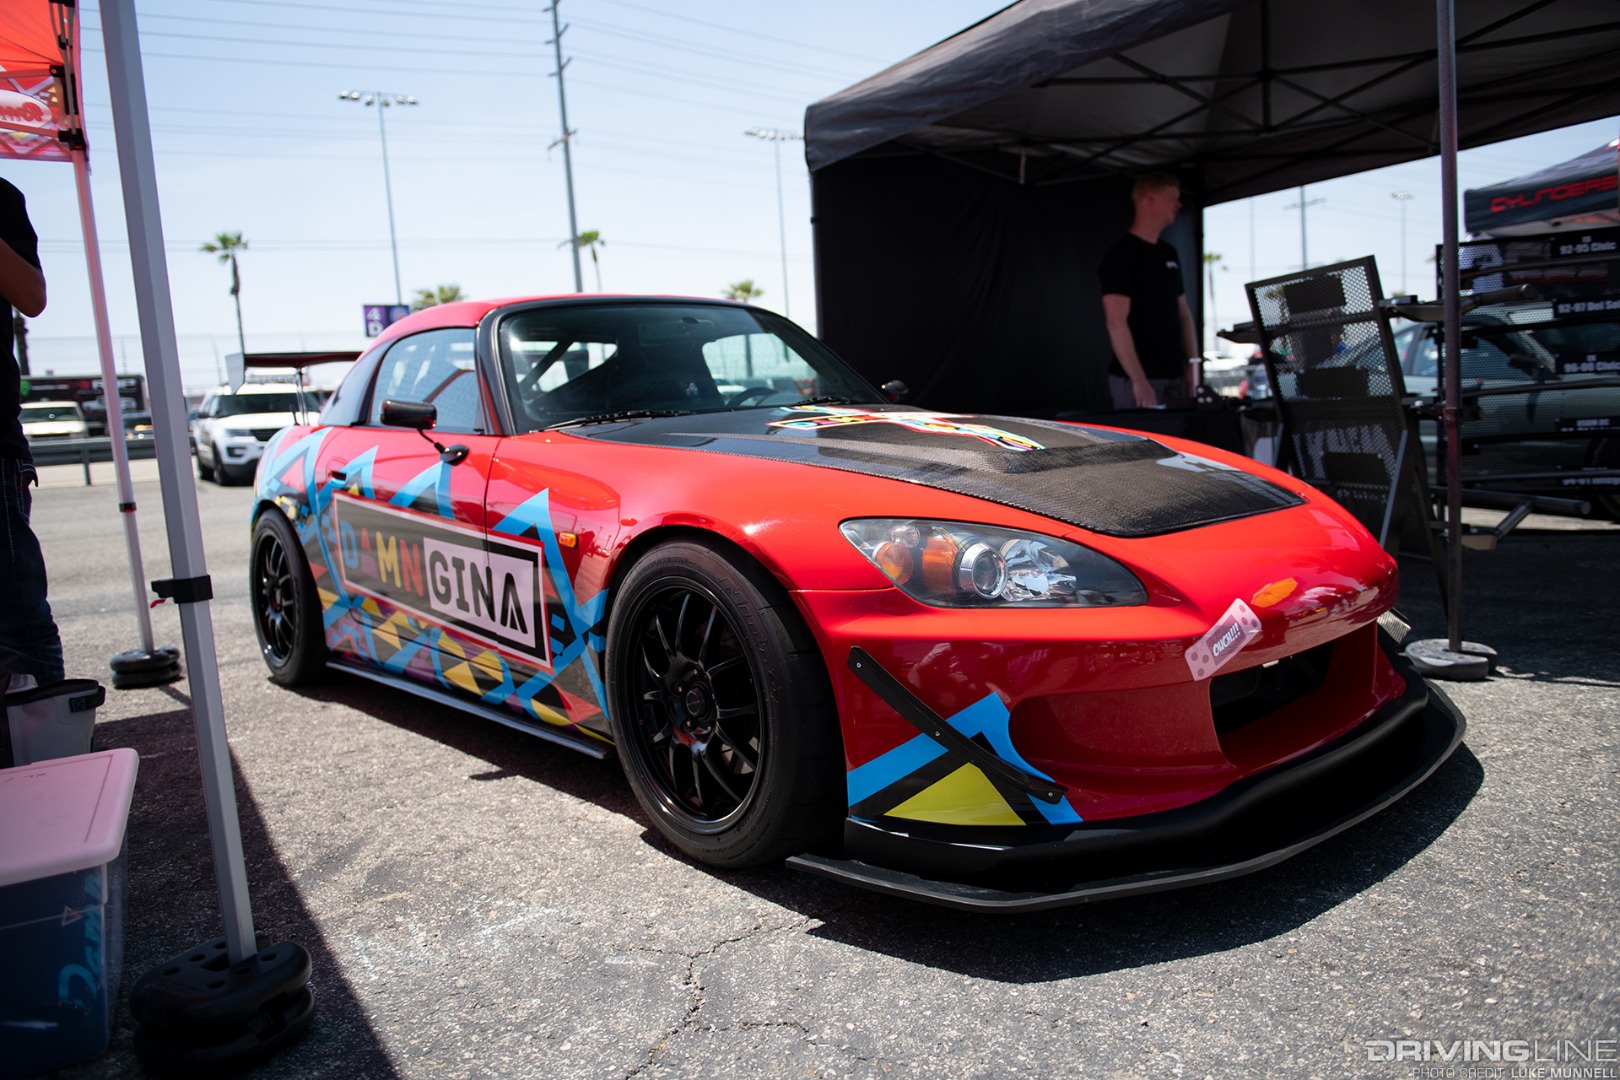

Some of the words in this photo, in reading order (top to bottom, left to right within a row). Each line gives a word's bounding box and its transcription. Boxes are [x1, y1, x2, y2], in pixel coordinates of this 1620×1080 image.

[341, 519, 424, 597] DAMN
[428, 549, 529, 635] GINA
[1212, 622, 1241, 657] OUCH!!!
